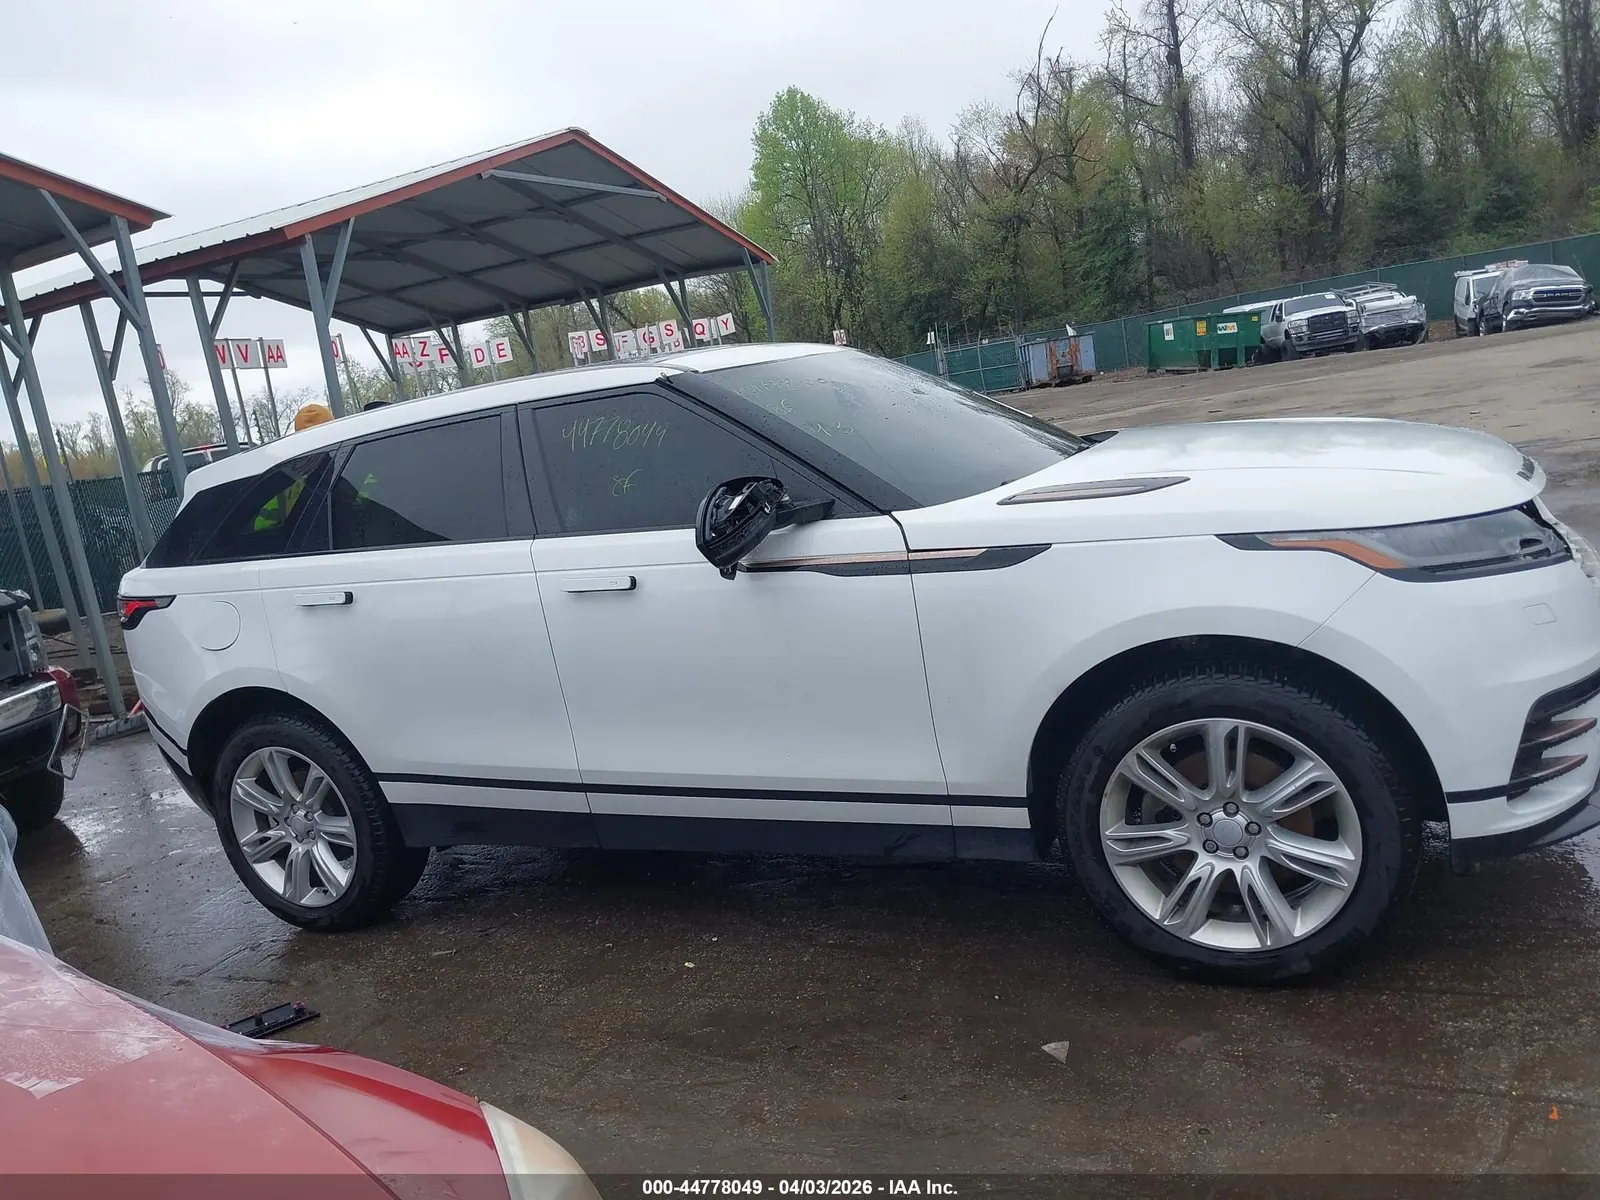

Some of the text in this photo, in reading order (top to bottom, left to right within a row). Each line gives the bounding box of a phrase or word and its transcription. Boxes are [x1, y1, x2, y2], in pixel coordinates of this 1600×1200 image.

[664, 323, 674, 337] S
[693, 322, 706, 336] Q
[721, 317, 729, 331] Y
[594, 332, 607, 346] S
[236, 344, 249, 363] V
[267, 344, 285, 363] AA
[393, 342, 410, 359] AA
[418, 341, 430, 357] Z
[437, 347, 450, 364] F
[473, 347, 486, 364] D
[495, 342, 507, 359] E
